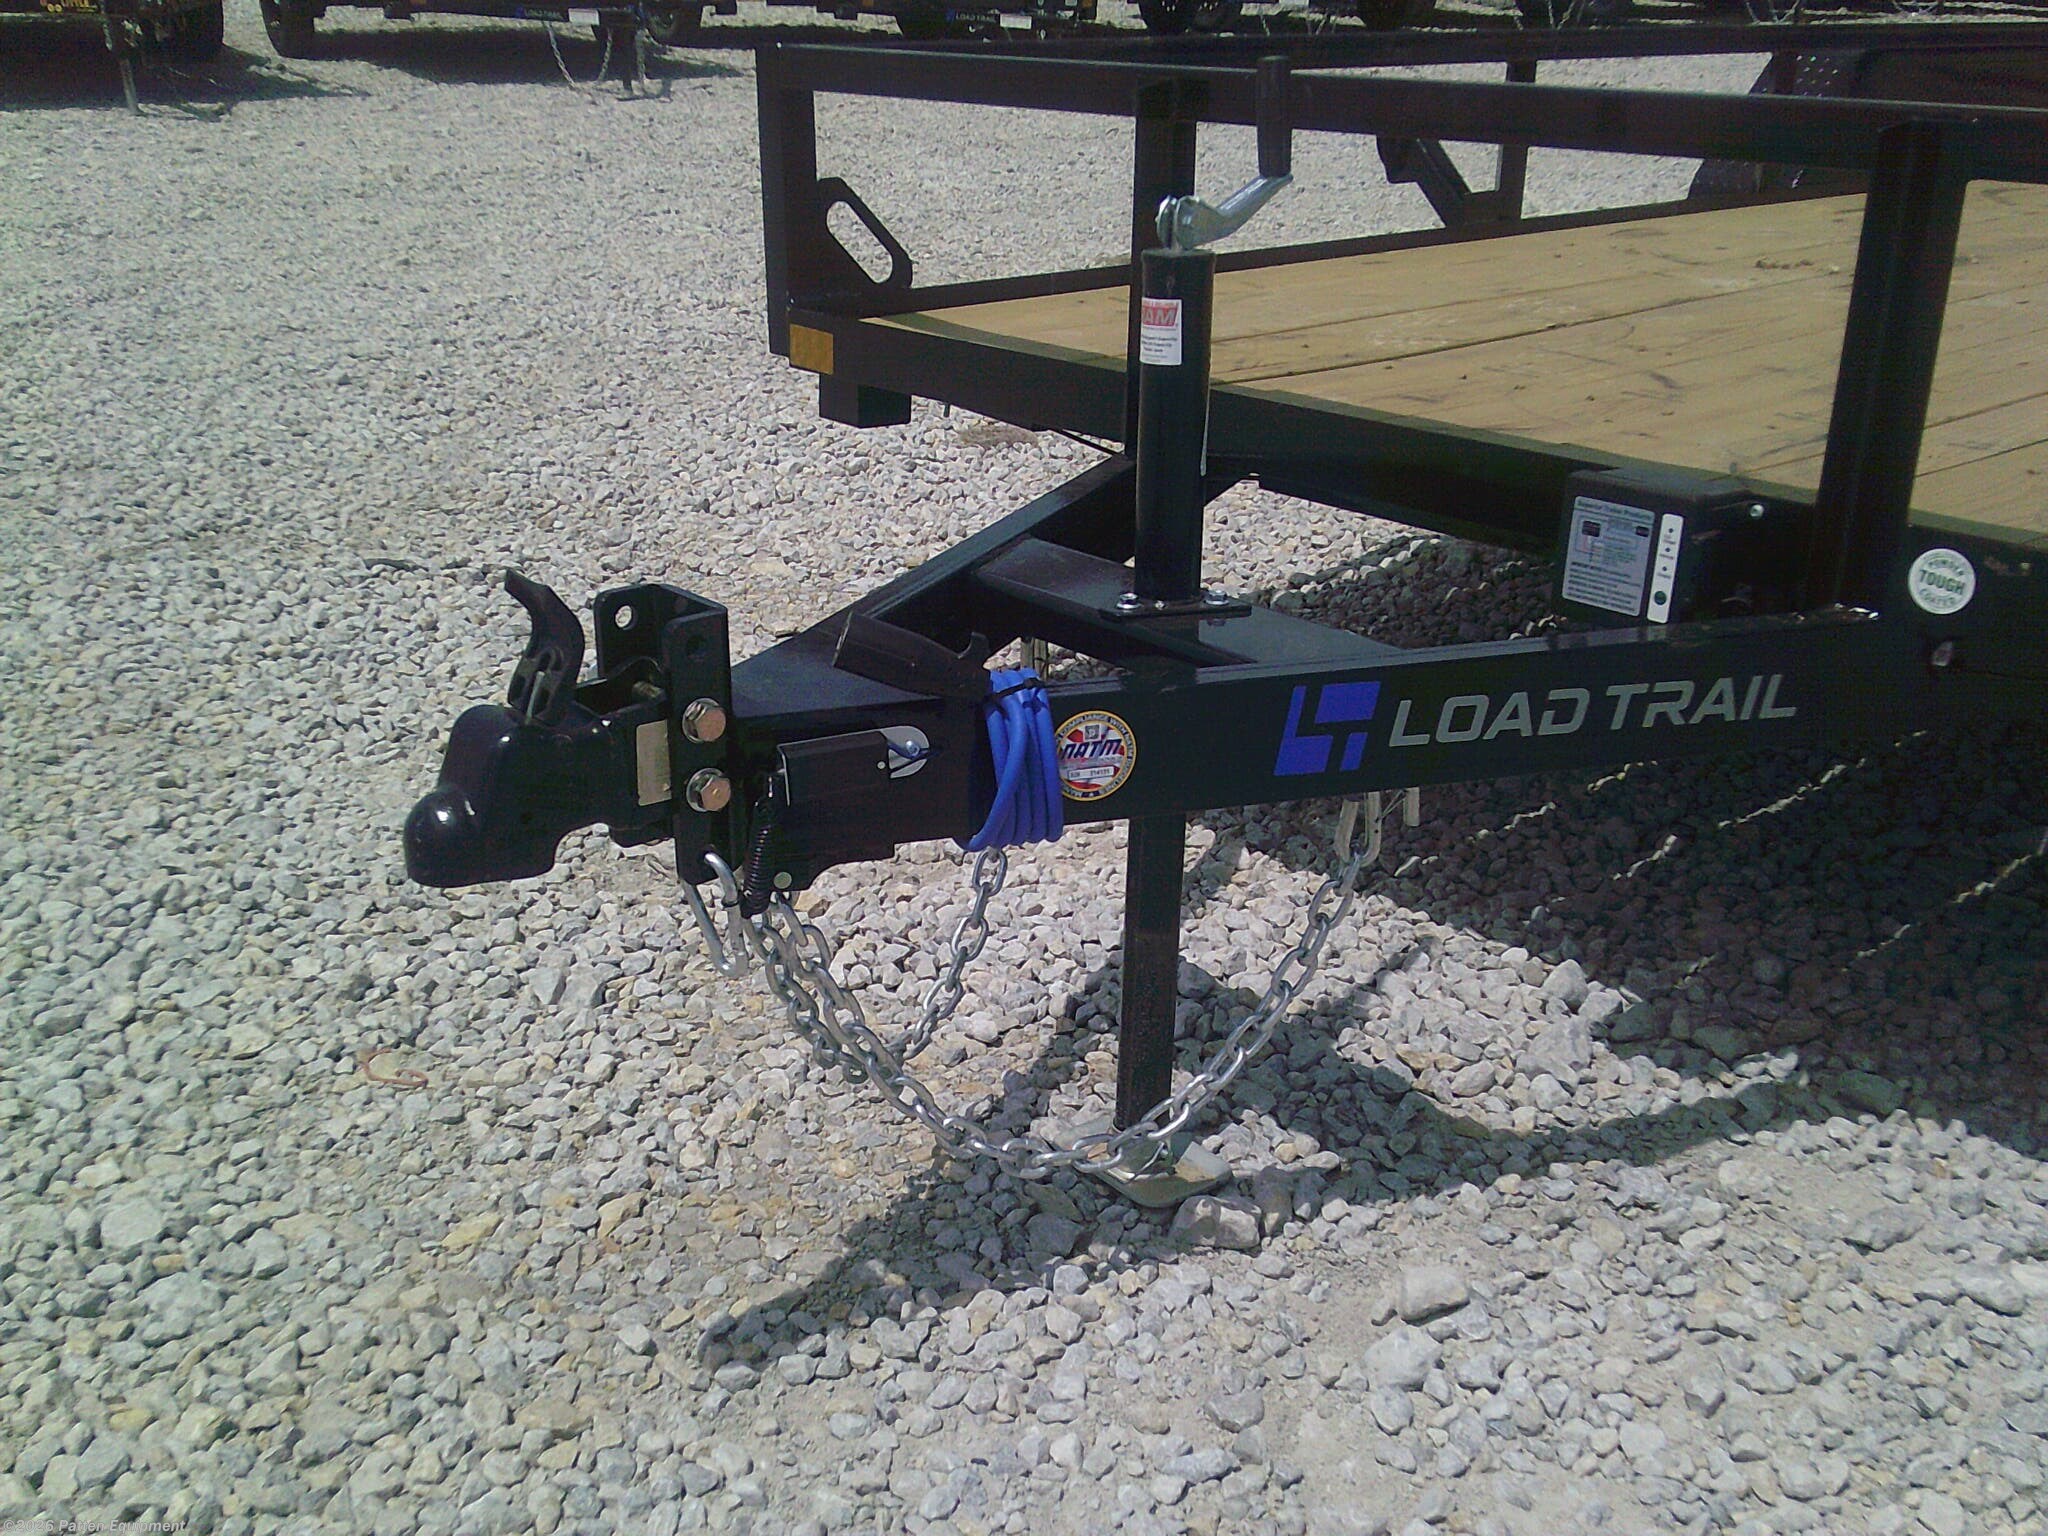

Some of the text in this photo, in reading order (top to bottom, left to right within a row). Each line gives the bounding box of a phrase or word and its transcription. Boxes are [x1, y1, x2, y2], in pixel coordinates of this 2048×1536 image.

[1920, 569, 1966, 595] TOUGH
[1388, 691, 1591, 747] LOAD
[1606, 674, 1797, 730] TRAIL
[1062, 739, 1122, 760] NATM
